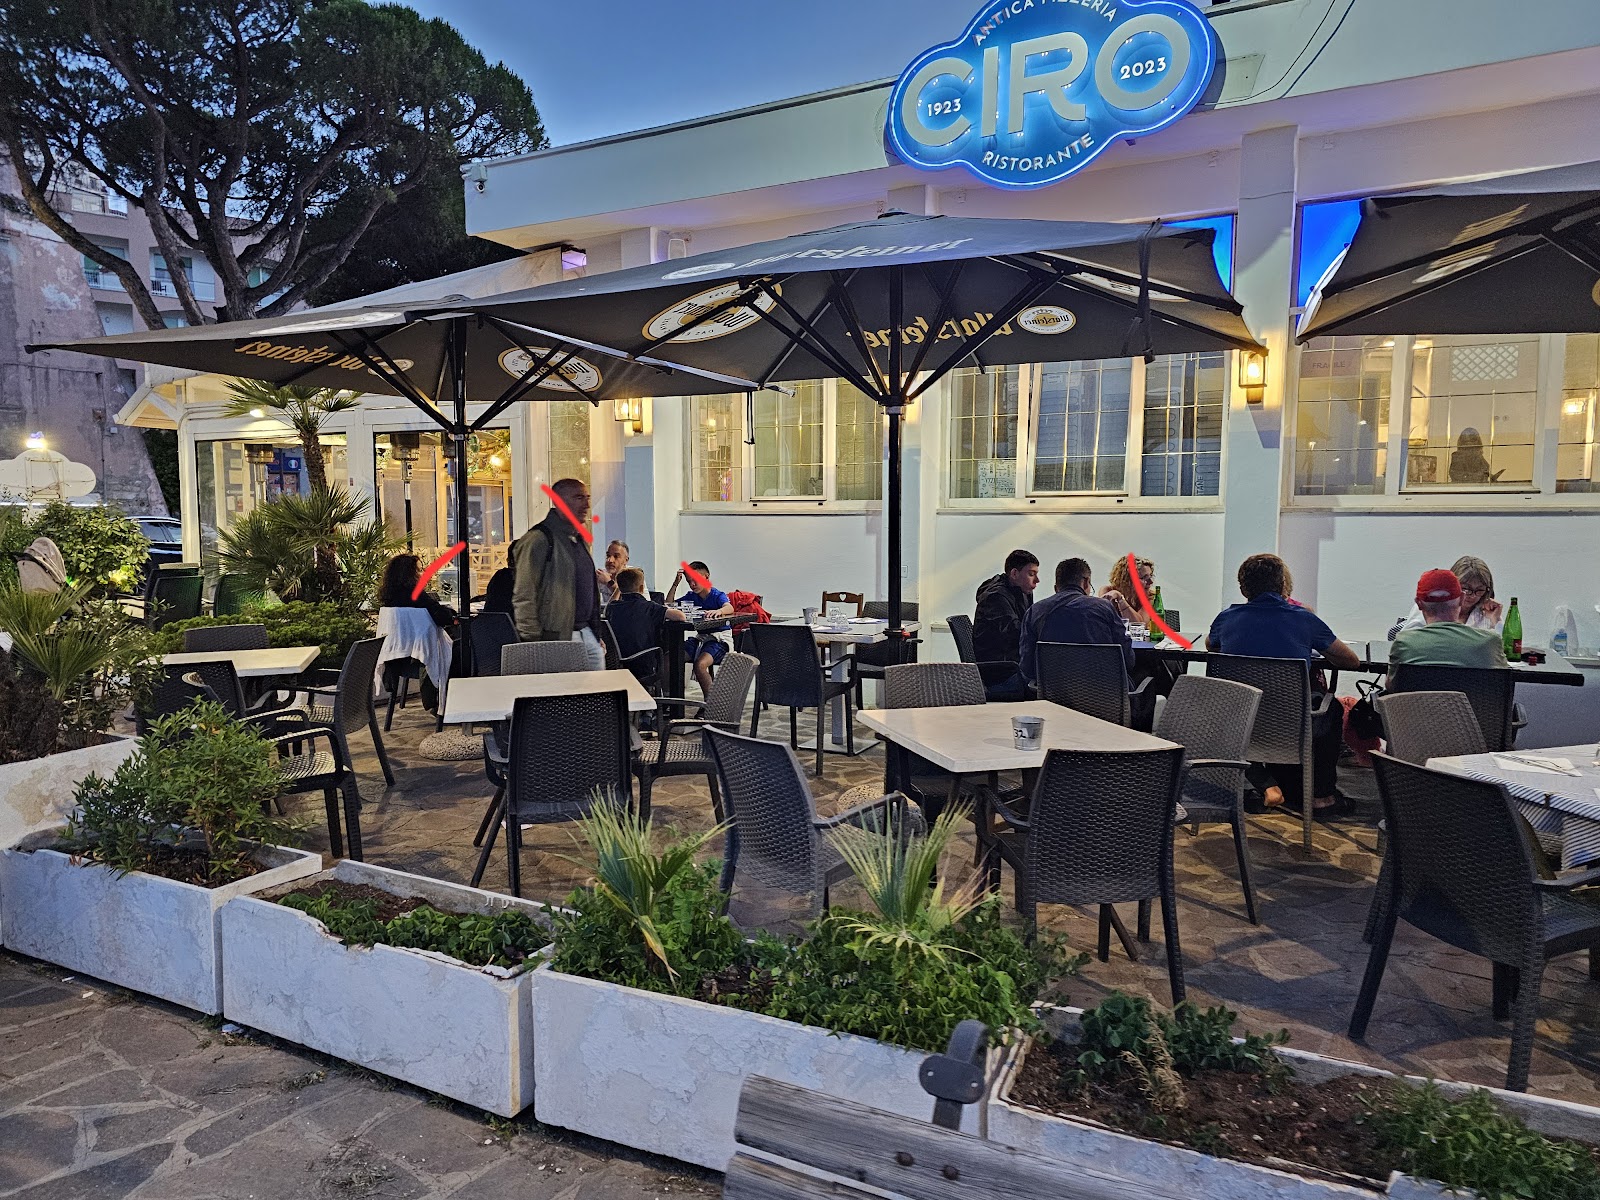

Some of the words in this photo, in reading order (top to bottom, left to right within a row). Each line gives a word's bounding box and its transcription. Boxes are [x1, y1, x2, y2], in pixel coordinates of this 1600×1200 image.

[972, 0, 1035, 47] ANTICA
[1042, 0, 1118, 23] ERIA
[902, 13, 1191, 147] CIRO
[1120, 57, 1167, 80] 2023
[927, 98, 962, 117] 1923
[982, 132, 1095, 172] RISTORANTE
[1312, 361, 1346, 369] FRAILE
